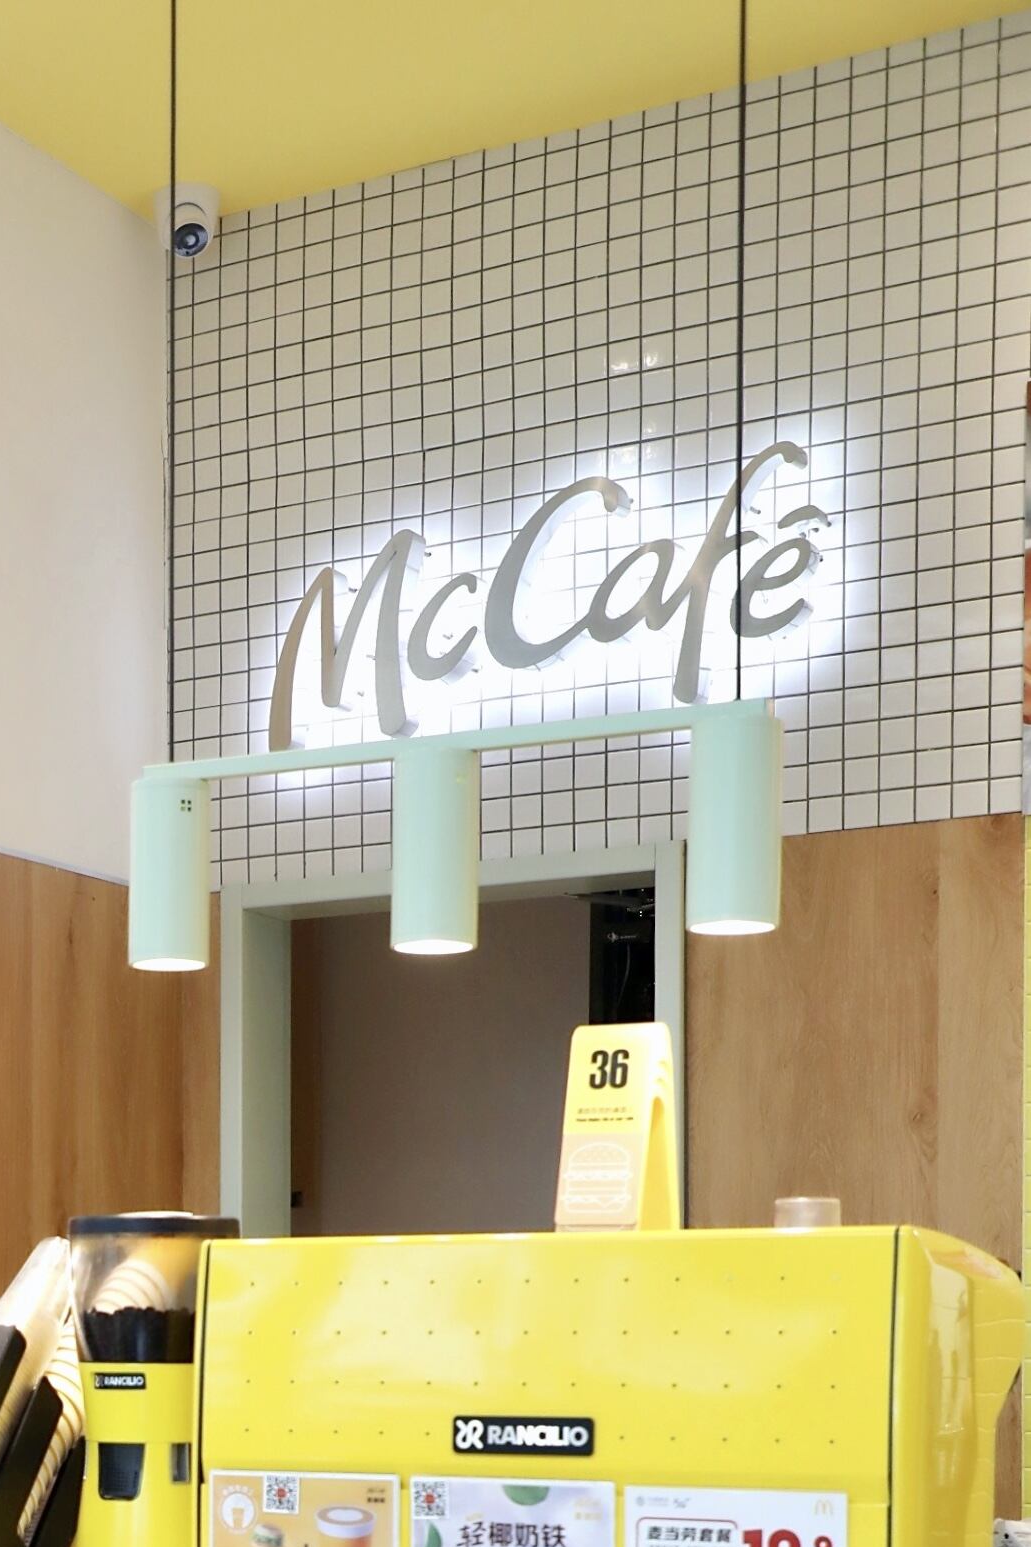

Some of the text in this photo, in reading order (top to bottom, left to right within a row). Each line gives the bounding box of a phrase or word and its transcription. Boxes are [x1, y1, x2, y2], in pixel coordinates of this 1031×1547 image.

[269, 440, 831, 752] McCafé
[588, 1049, 630, 1089] 36
[487, 1425, 589, 1447] RANCILIO
[647, 1526, 732, 1543] 麦当劳套餐
